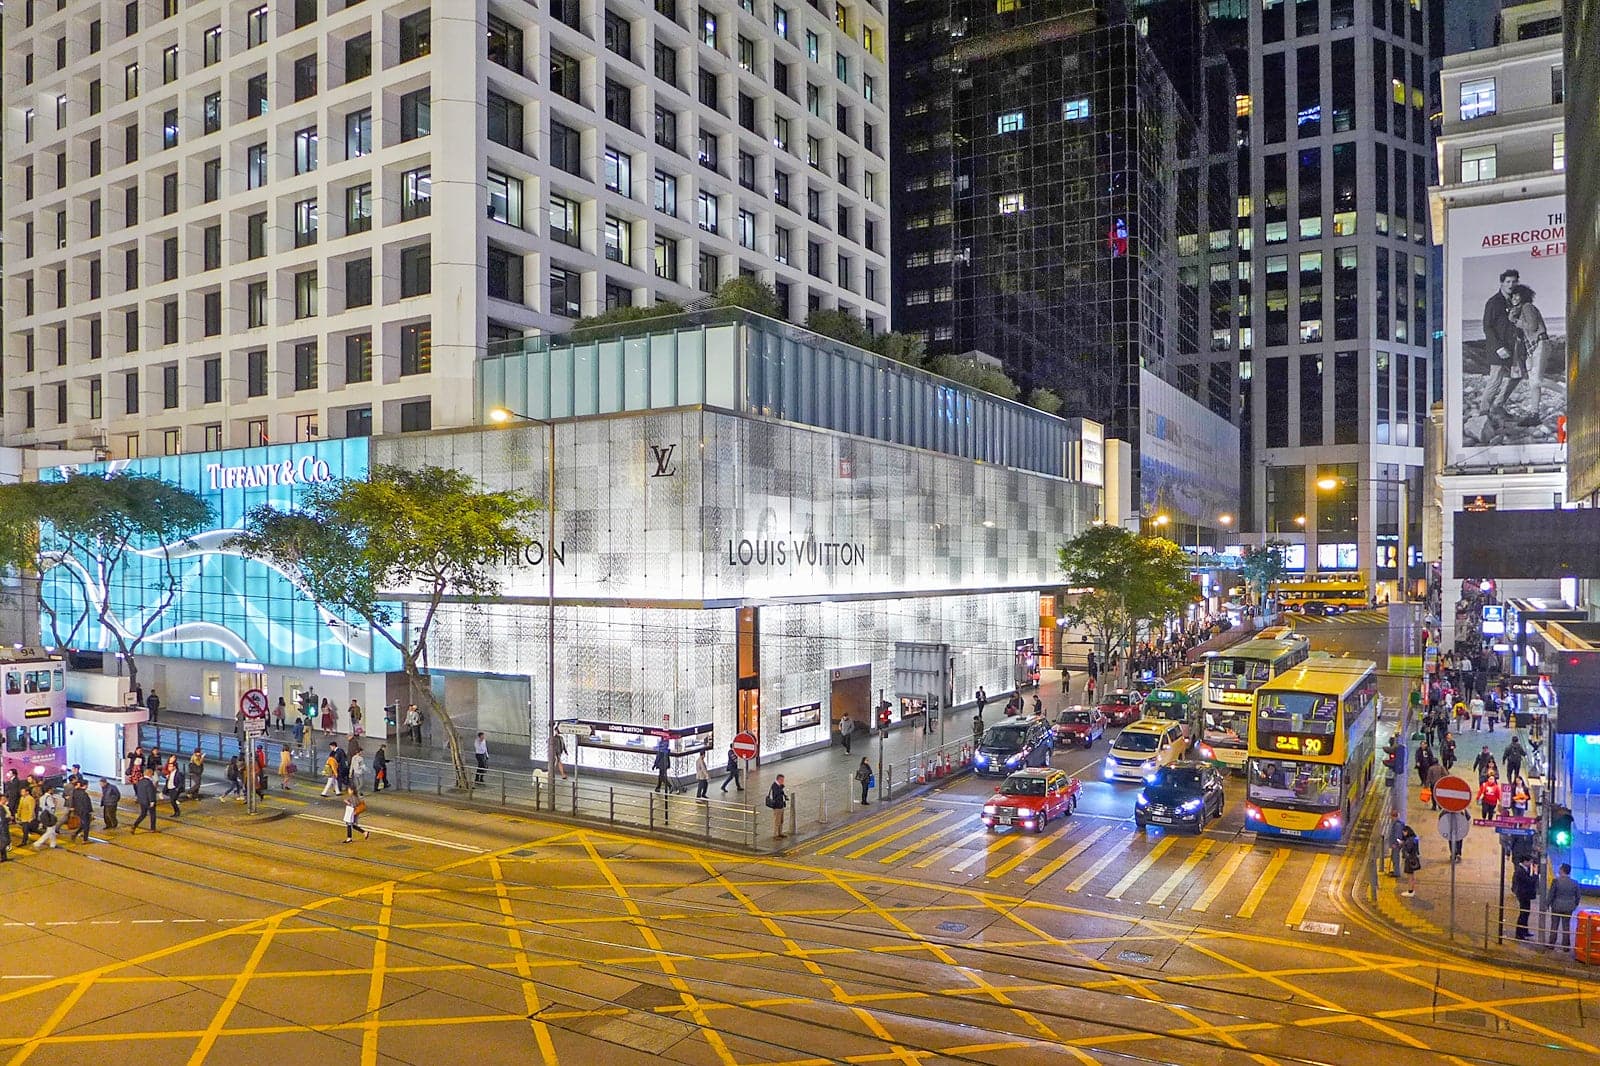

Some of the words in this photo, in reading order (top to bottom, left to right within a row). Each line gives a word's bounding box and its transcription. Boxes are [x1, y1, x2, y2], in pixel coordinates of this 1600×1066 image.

[1548, 213, 1566, 225] TH
[1482, 227, 1564, 248] ABERCROM
[1531, 245, 1541, 257] &
[207, 463, 281, 490] TIFFANY
[728, 539, 786, 566] LOUIS
[794, 541, 865, 567] VUITTON
[20, 648, 36, 657] 94
[1305, 739, 1321, 751] 90
